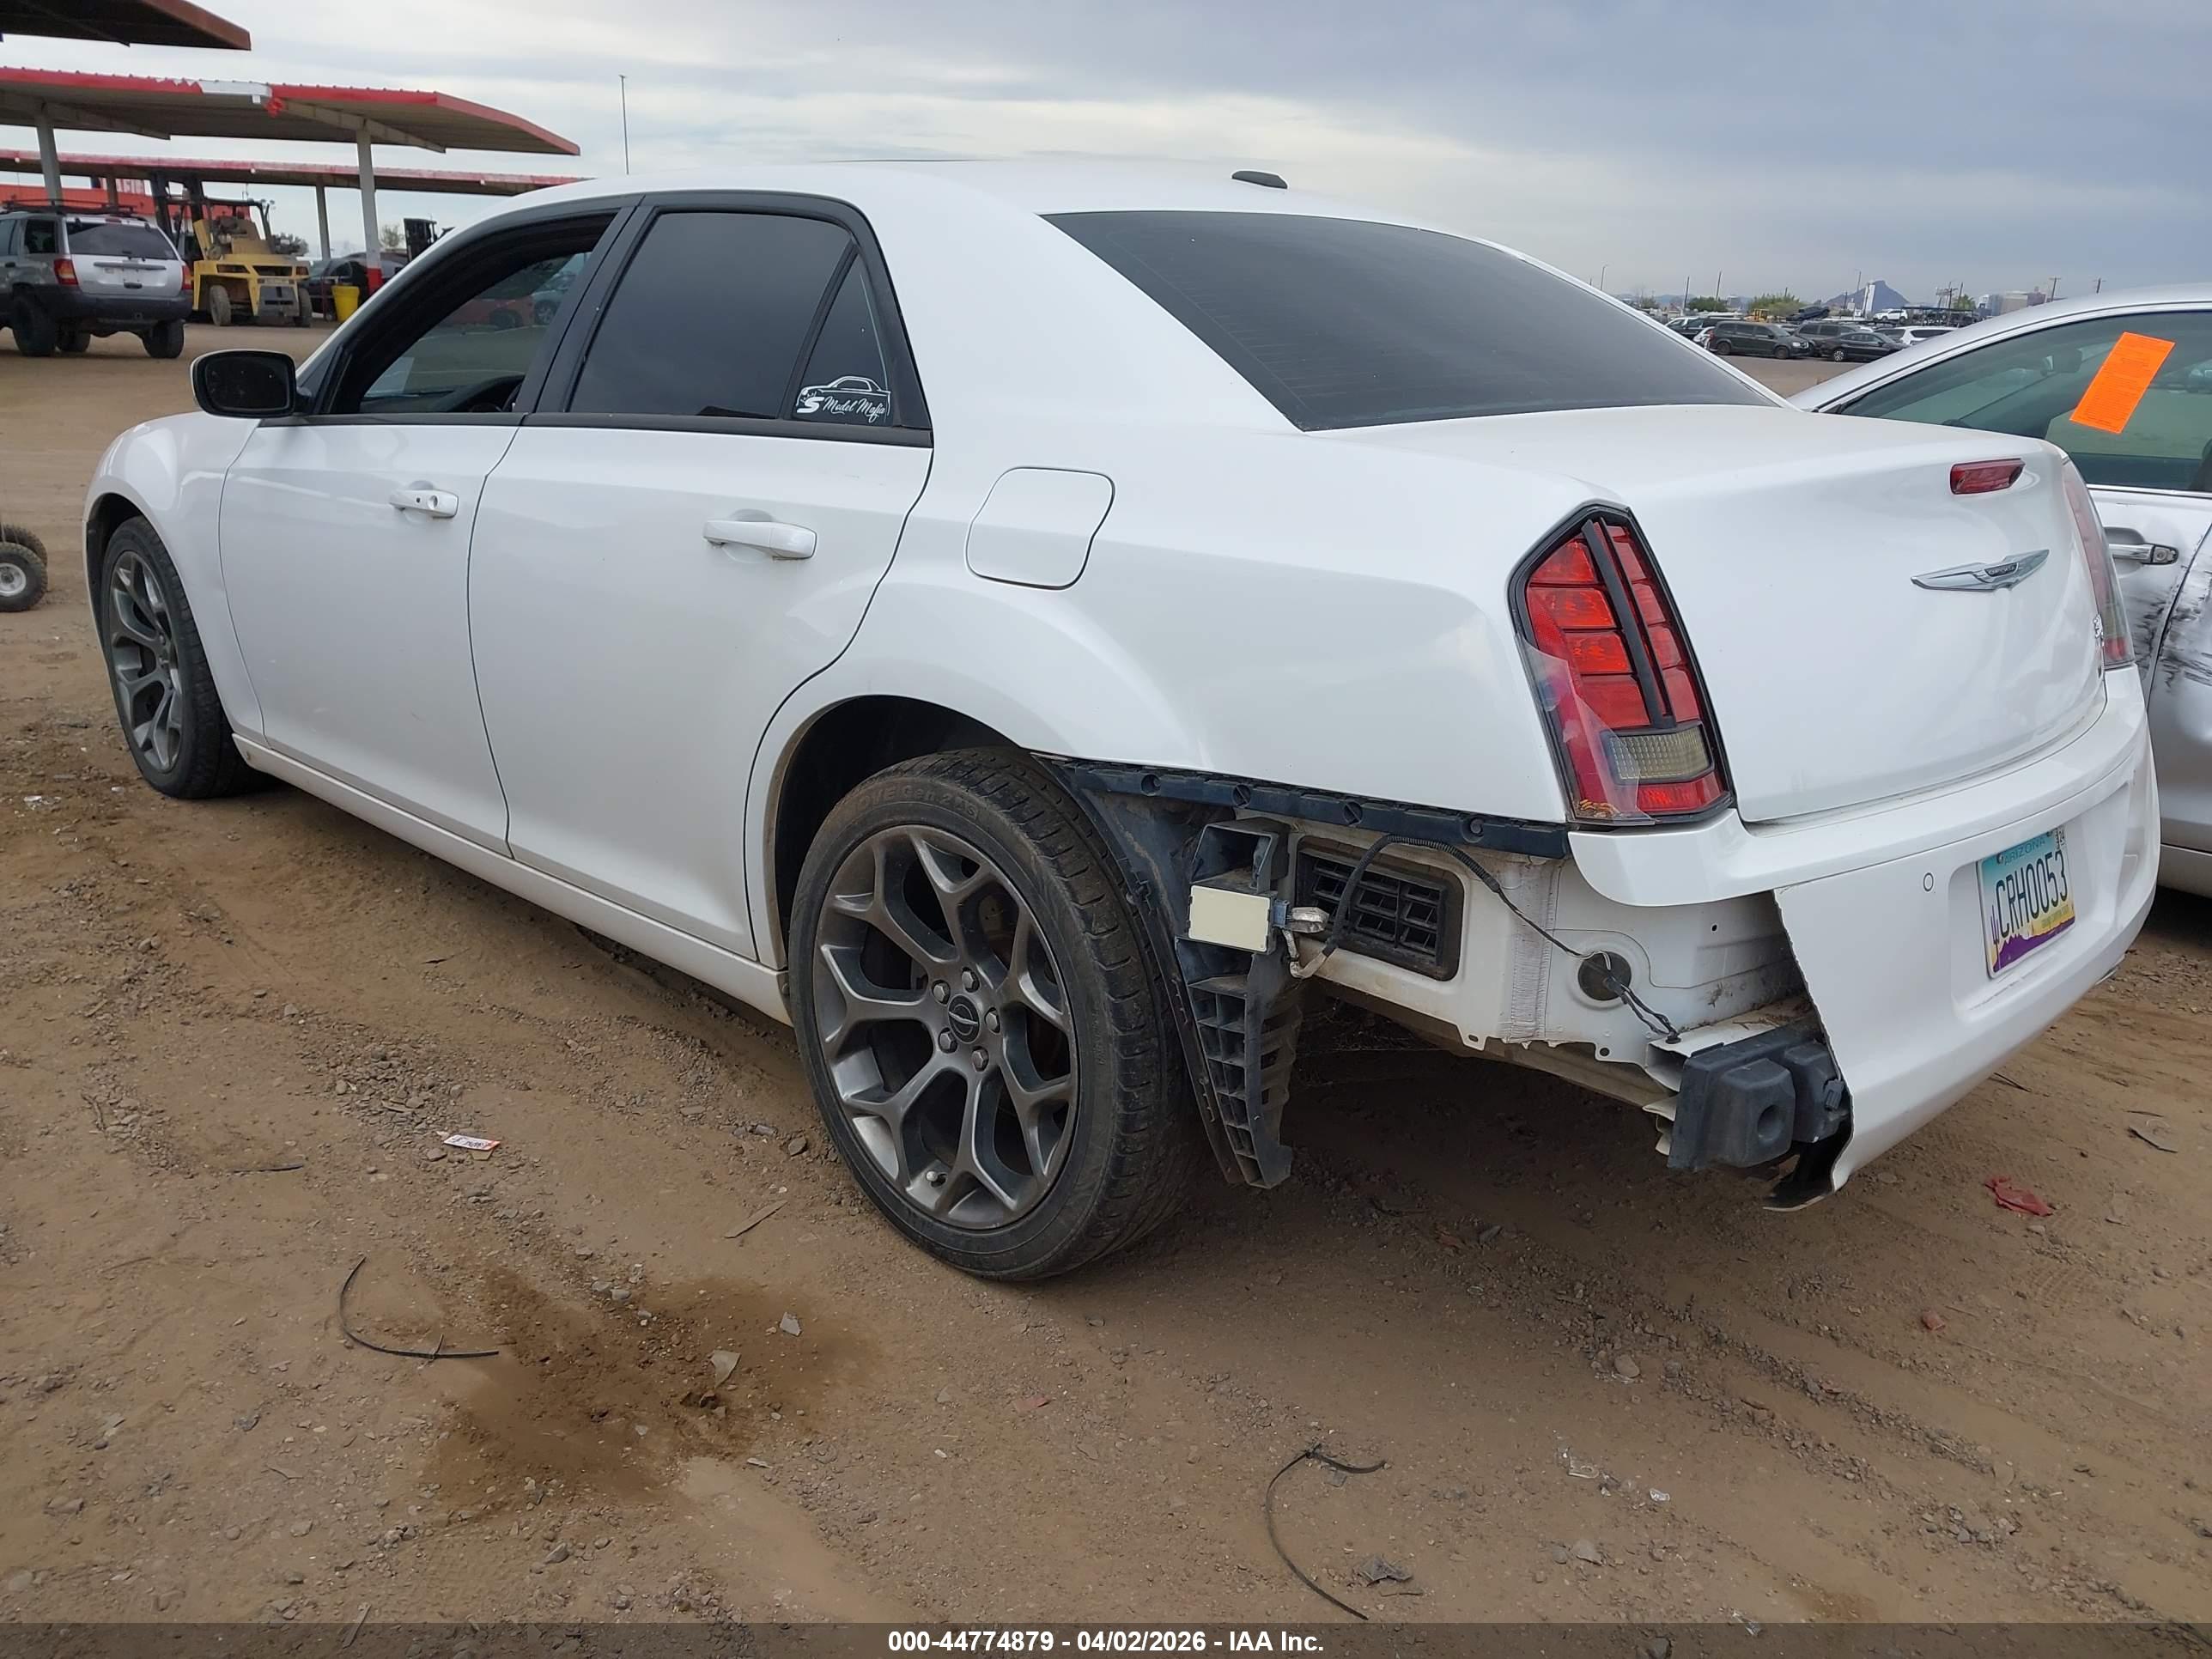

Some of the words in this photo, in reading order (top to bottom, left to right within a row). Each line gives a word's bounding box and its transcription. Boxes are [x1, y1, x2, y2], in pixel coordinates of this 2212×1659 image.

[823, 396, 854, 415] Model
[856, 398, 885, 423] Mafia
[2003, 836, 2047, 866] ARIZONA
[1995, 849, 2069, 939] CRH0053
